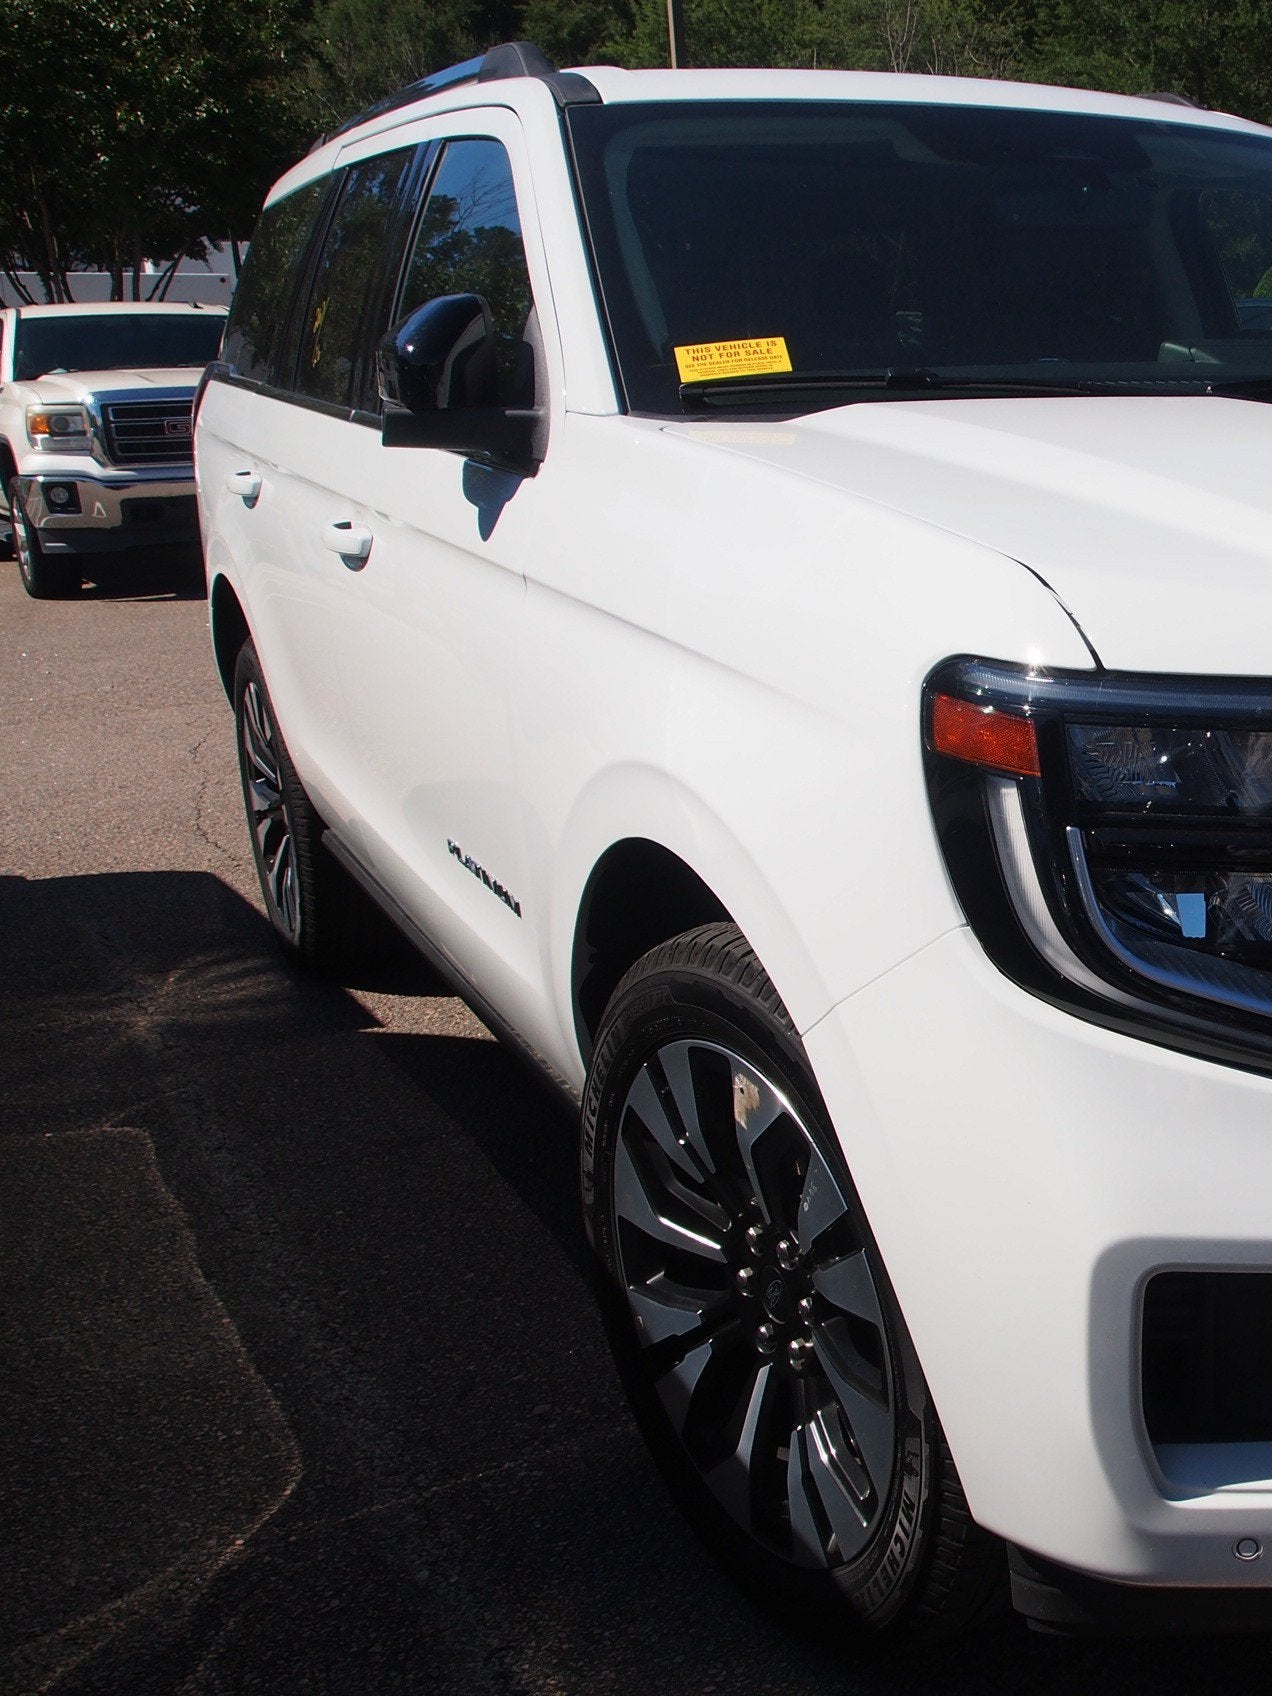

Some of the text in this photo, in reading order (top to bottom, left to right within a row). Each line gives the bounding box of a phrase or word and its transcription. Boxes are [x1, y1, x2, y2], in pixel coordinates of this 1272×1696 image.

[715, 340, 763, 352] VEHICLE
[691, 347, 774, 362] NOT FOR SALE
